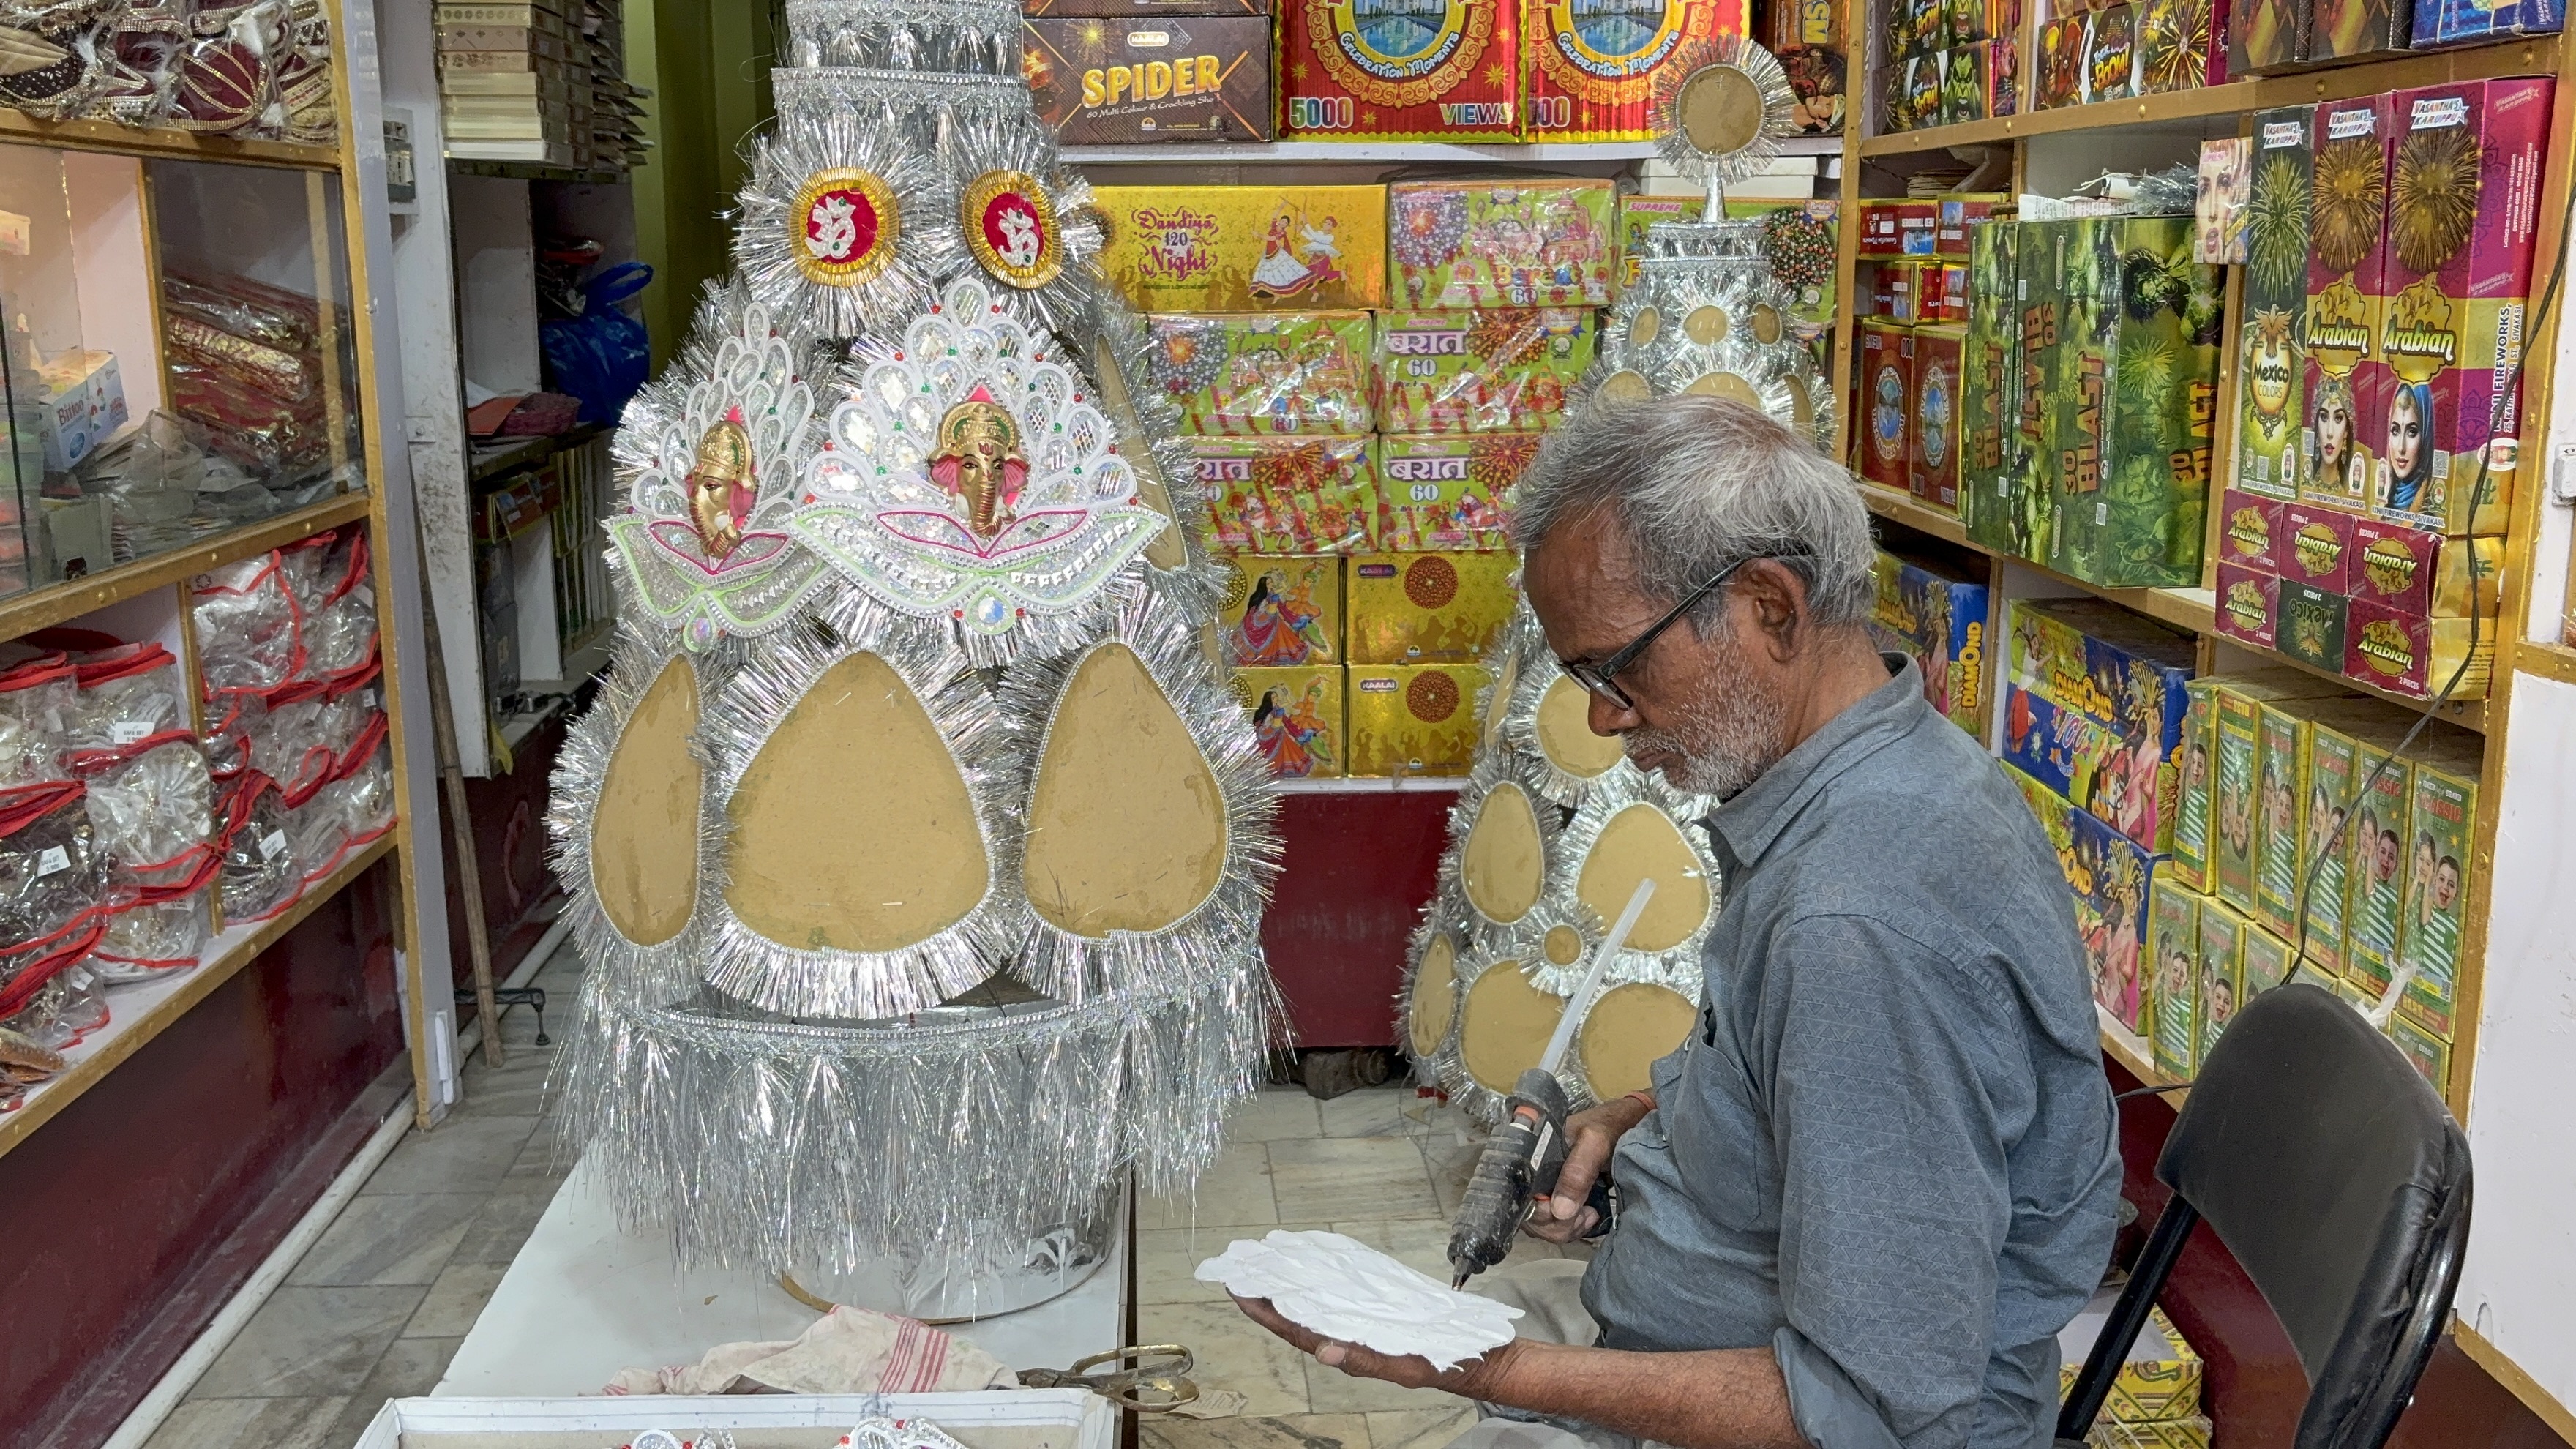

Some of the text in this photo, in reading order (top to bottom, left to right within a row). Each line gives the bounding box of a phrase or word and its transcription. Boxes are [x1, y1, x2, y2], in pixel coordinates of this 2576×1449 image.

[1802, 0, 1830, 43] SM
[1339, 31, 1460, 78] CELEBRATION MOMENTS
[1557, 29, 1680, 77] CELEBRATION MOMENTS
[1081, 55, 1221, 108] SPIDER
[1099, 108, 1119, 118] Multi
[1121, 105, 1147, 114] Colour
[1158, 98, 1196, 109] Crackling
[1197, 95, 1215, 104] Sho
[1289, 97, 1515, 129] 5000 VIEWS
[2331, 111, 2370, 124] VASANTHA'S
[2414, 99, 2461, 115] VASANTHA'S
[2414, 113, 2457, 126] KARUPPU
[2264, 134, 2296, 146] KARUPPU
[2265, 123, 2299, 135] VASANTHA'S
[2331, 123, 2367, 135] KARUPPU
[1137, 210, 1214, 236] Dandiya
[1630, 202, 1682, 212] SUPREME
[1164, 231, 1188, 247] 120
[1142, 245, 1209, 282] Night
[2042, 302, 2056, 346] 30
[2308, 312, 2370, 356] Arabian
[2383, 315, 2455, 363] Arabian
[2494, 303, 2512, 390] FIREWORKS,
[1406, 359, 1437, 377] 60
[2021, 302, 2044, 443] BLAST
[2253, 362, 2289, 383] Mexico
[1983, 340, 2003, 469] BLAST
[2258, 386, 2283, 398] COLORS
[2077, 350, 2105, 493] BLAST
[2189, 378, 2218, 483] BLAST
[2504, 420, 2515, 433] 25,
[1389, 457, 1469, 480] बरात
[2062, 449, 2079, 495] 30
[2169, 448, 2195, 485] 30
[1409, 484, 1440, 502] 60
[2228, 523, 2269, 550] Arabian
[2295, 531, 2343, 563] Arabian
[2364, 546, 2418, 580] Arabian
[2225, 597, 2267, 624] Arabian
[2289, 598, 2334, 628] Mexico
[1958, 621, 1983, 708] DIAMOND
[2358, 635, 2414, 670] Arabian
[2054, 668, 2115, 723] DIAMOND
[2403, 677, 2419, 690] PIECES
[2053, 711, 2092, 755] 100
[2419, 792, 2463, 824] CLASSIC
